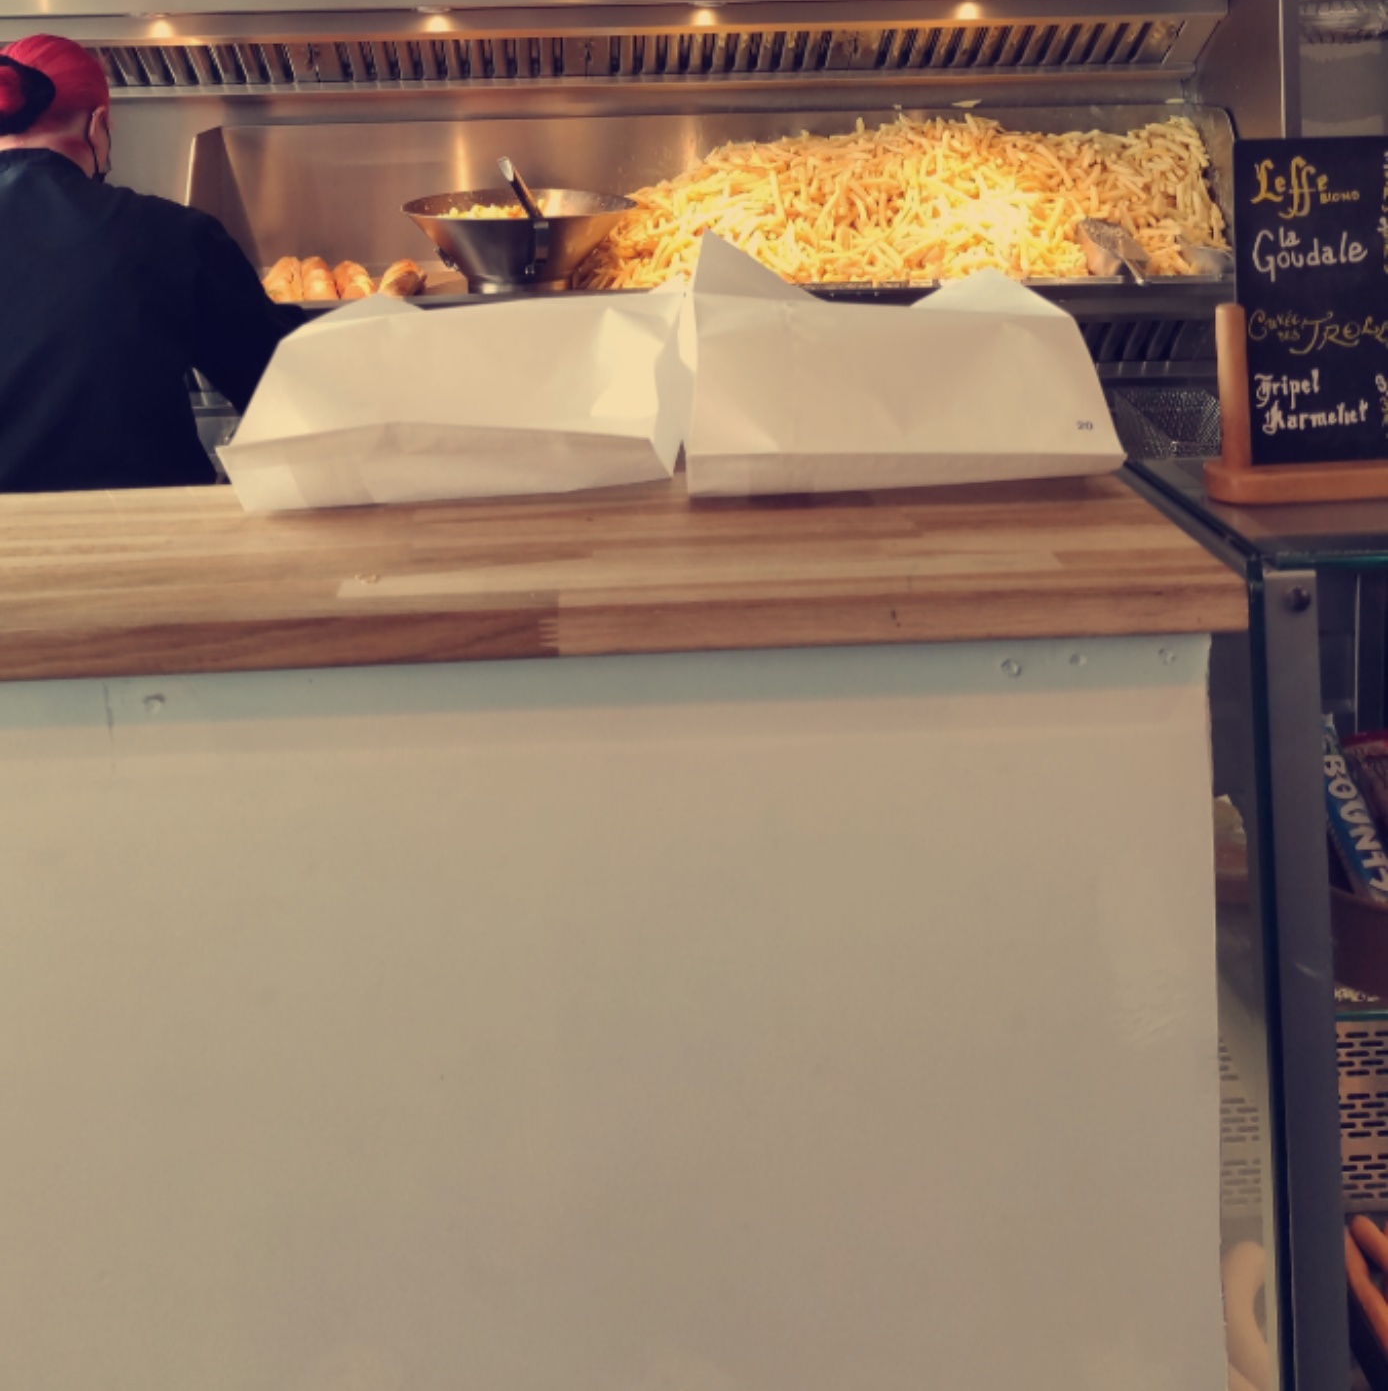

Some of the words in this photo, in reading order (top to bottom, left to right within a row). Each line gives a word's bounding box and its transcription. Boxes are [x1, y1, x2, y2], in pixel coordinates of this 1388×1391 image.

[1251, 155, 1330, 220] Leffe
[1252, 229, 1368, 283] Goudale
[1253, 367, 1320, 411] Tripel
